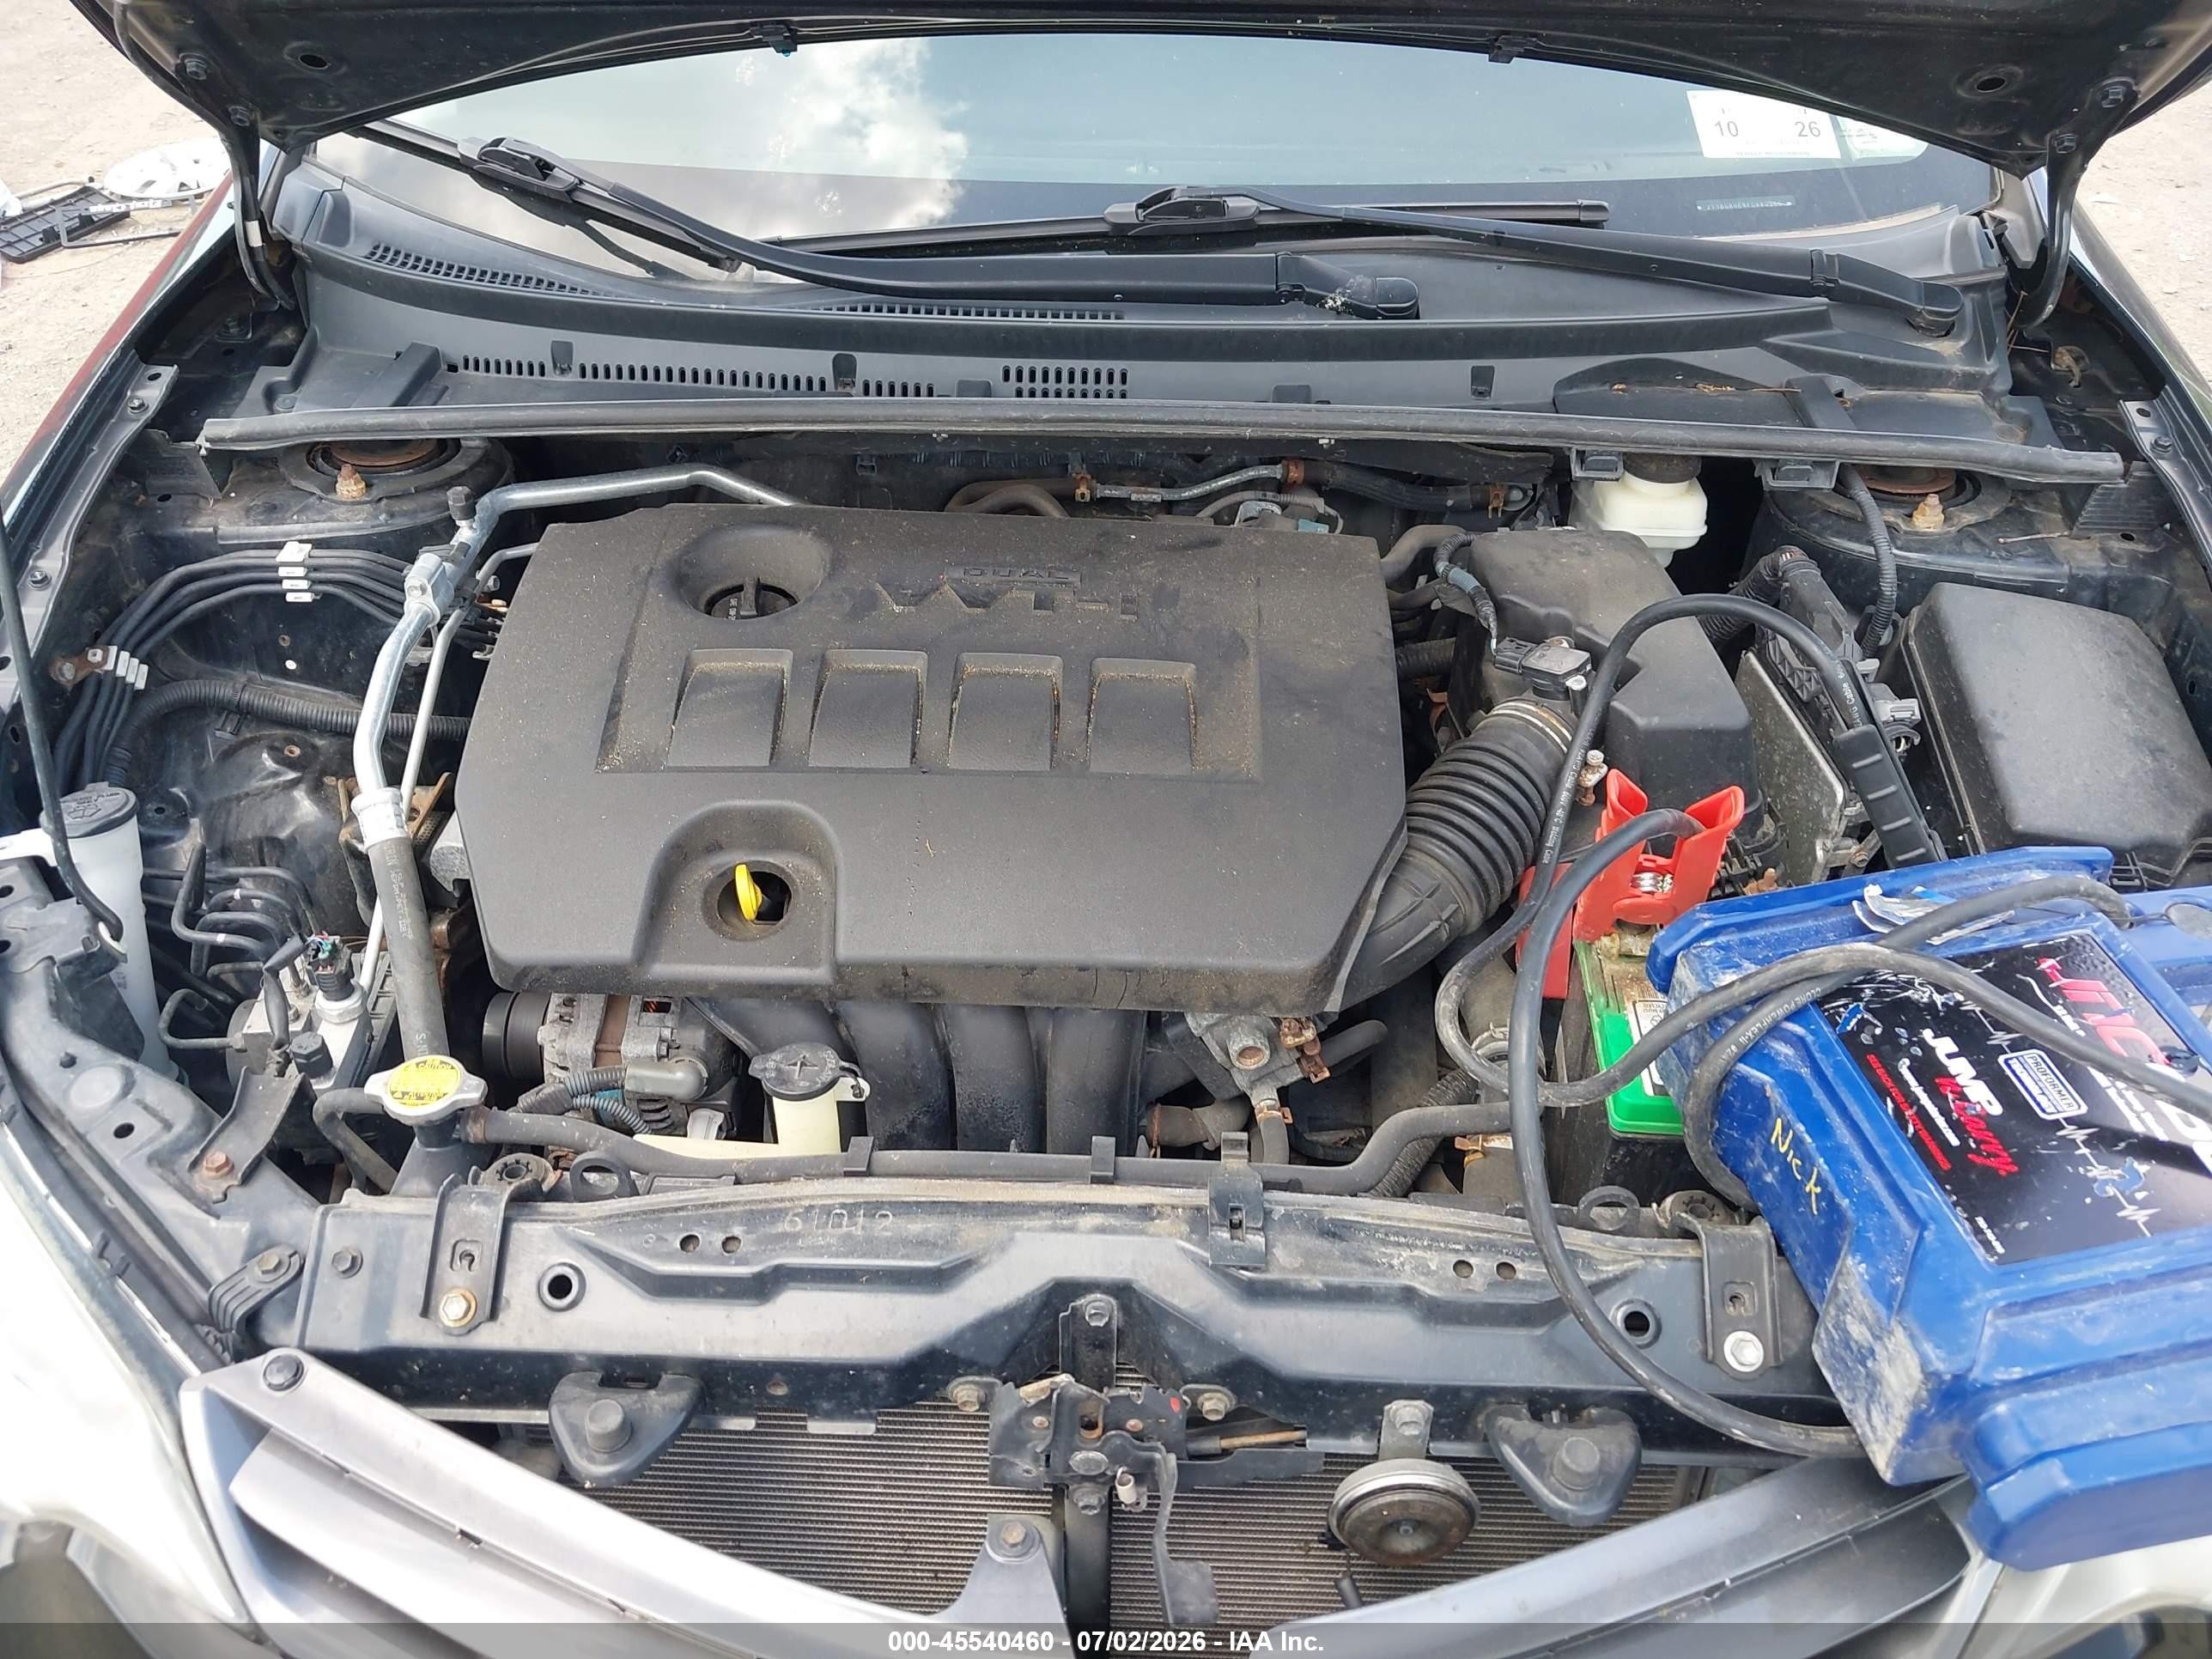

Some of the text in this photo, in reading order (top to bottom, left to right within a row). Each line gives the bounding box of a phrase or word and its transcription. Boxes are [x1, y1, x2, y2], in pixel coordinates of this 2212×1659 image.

[1714, 120, 1739, 137] 10
[1794, 121, 1821, 137] 26
[1842, 683, 1855, 704] Cable
[1565, 771, 1578, 789] Cable
[1546, 824, 1559, 848] Welding
[1541, 848, 1553, 865] Cable
[1795, 987, 1823, 1005] CLORE
[1922, 1029, 2002, 1115] JUMP
[2026, 1053, 2075, 1110] PROFORMER
